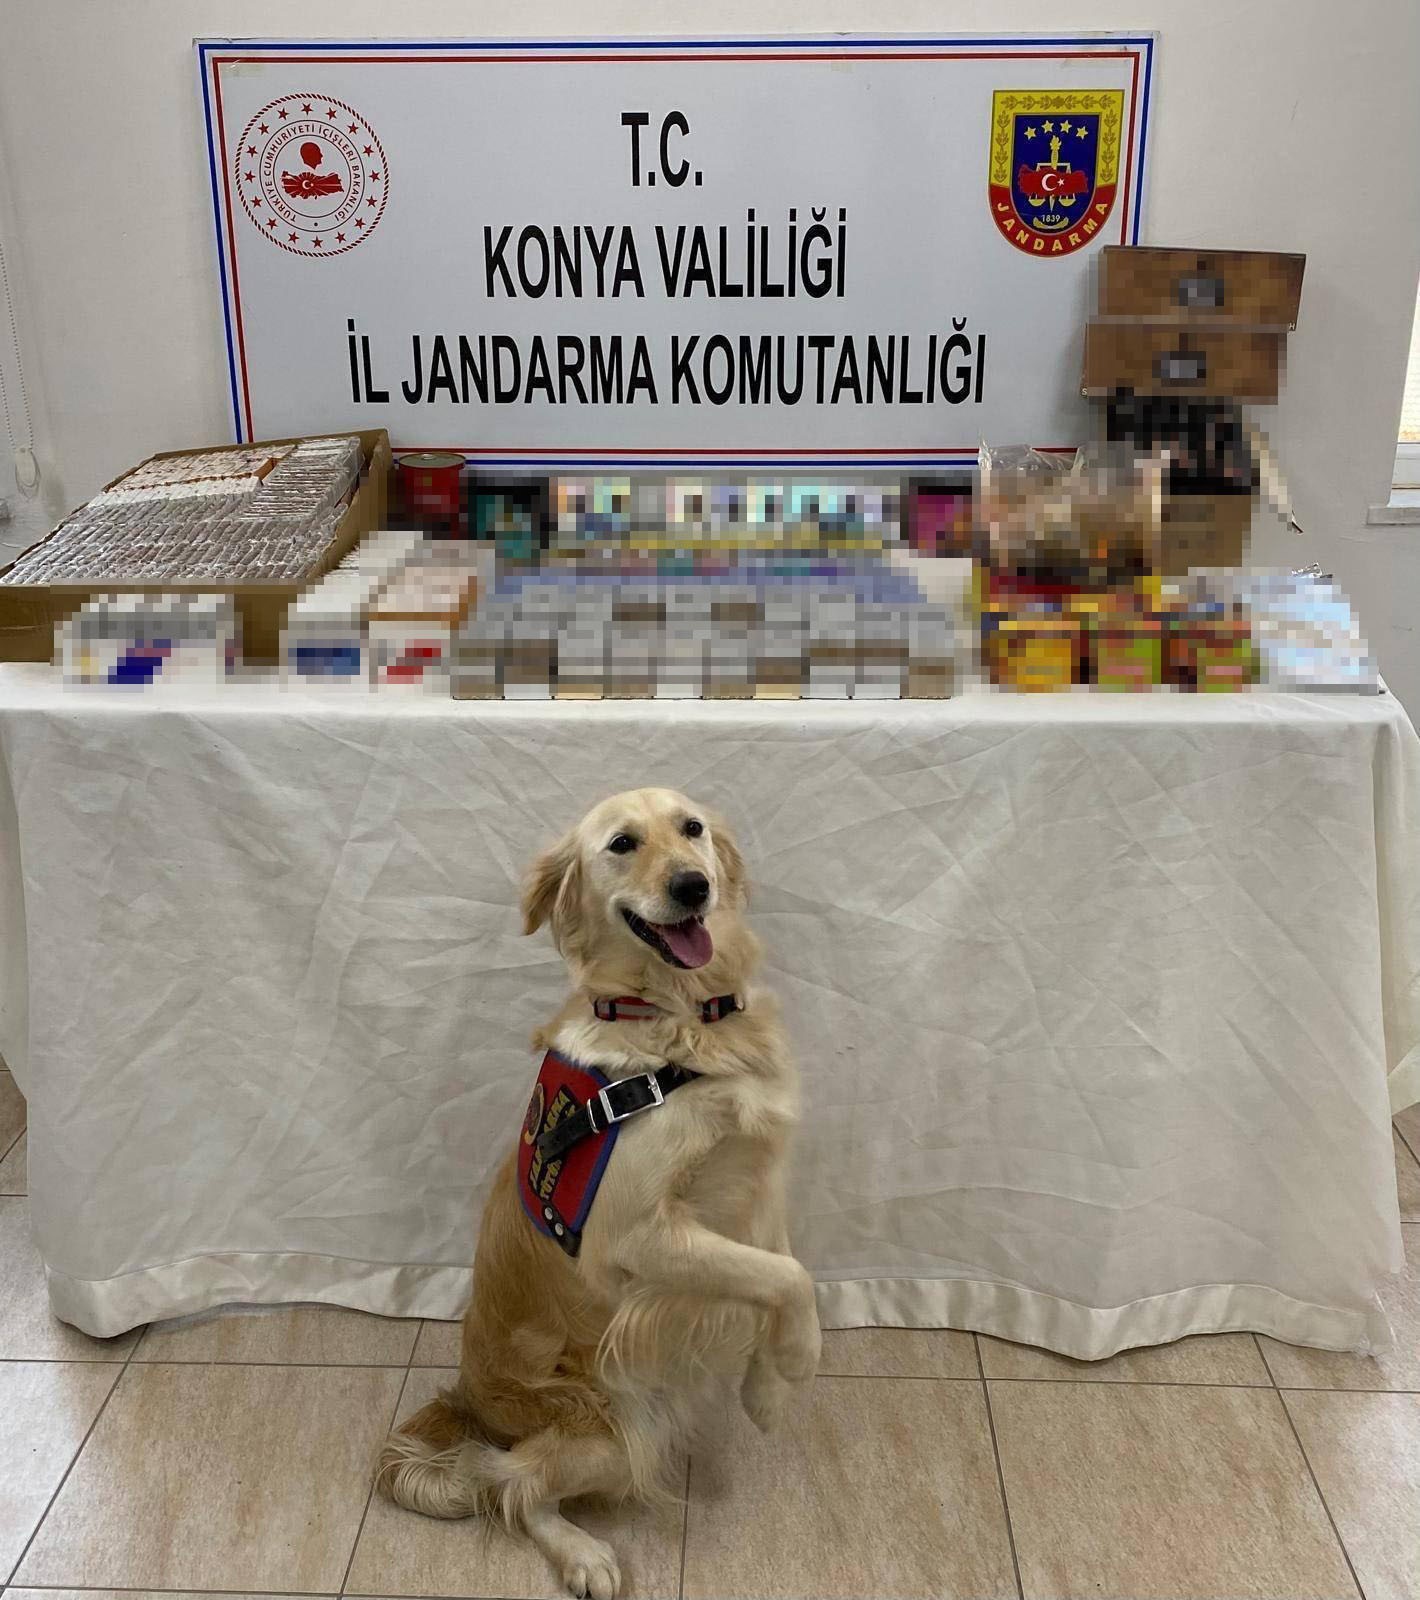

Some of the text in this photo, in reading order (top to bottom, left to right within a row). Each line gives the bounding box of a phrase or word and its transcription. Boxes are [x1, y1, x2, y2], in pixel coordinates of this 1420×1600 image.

[264, 124, 361, 222] TÜRKİYE CUMHURİYETİ İÇİŞLERİ BAKANLIĞI
[622, 111, 702, 187] T.C.
[484, 207, 846, 298] KONYA VALİLİĞİ
[997, 202, 1108, 251] JANDARMA
[1041, 214, 1061, 222] 1839
[348, 317, 985, 405] İL JANDARMA KOMUTANLIĞI
